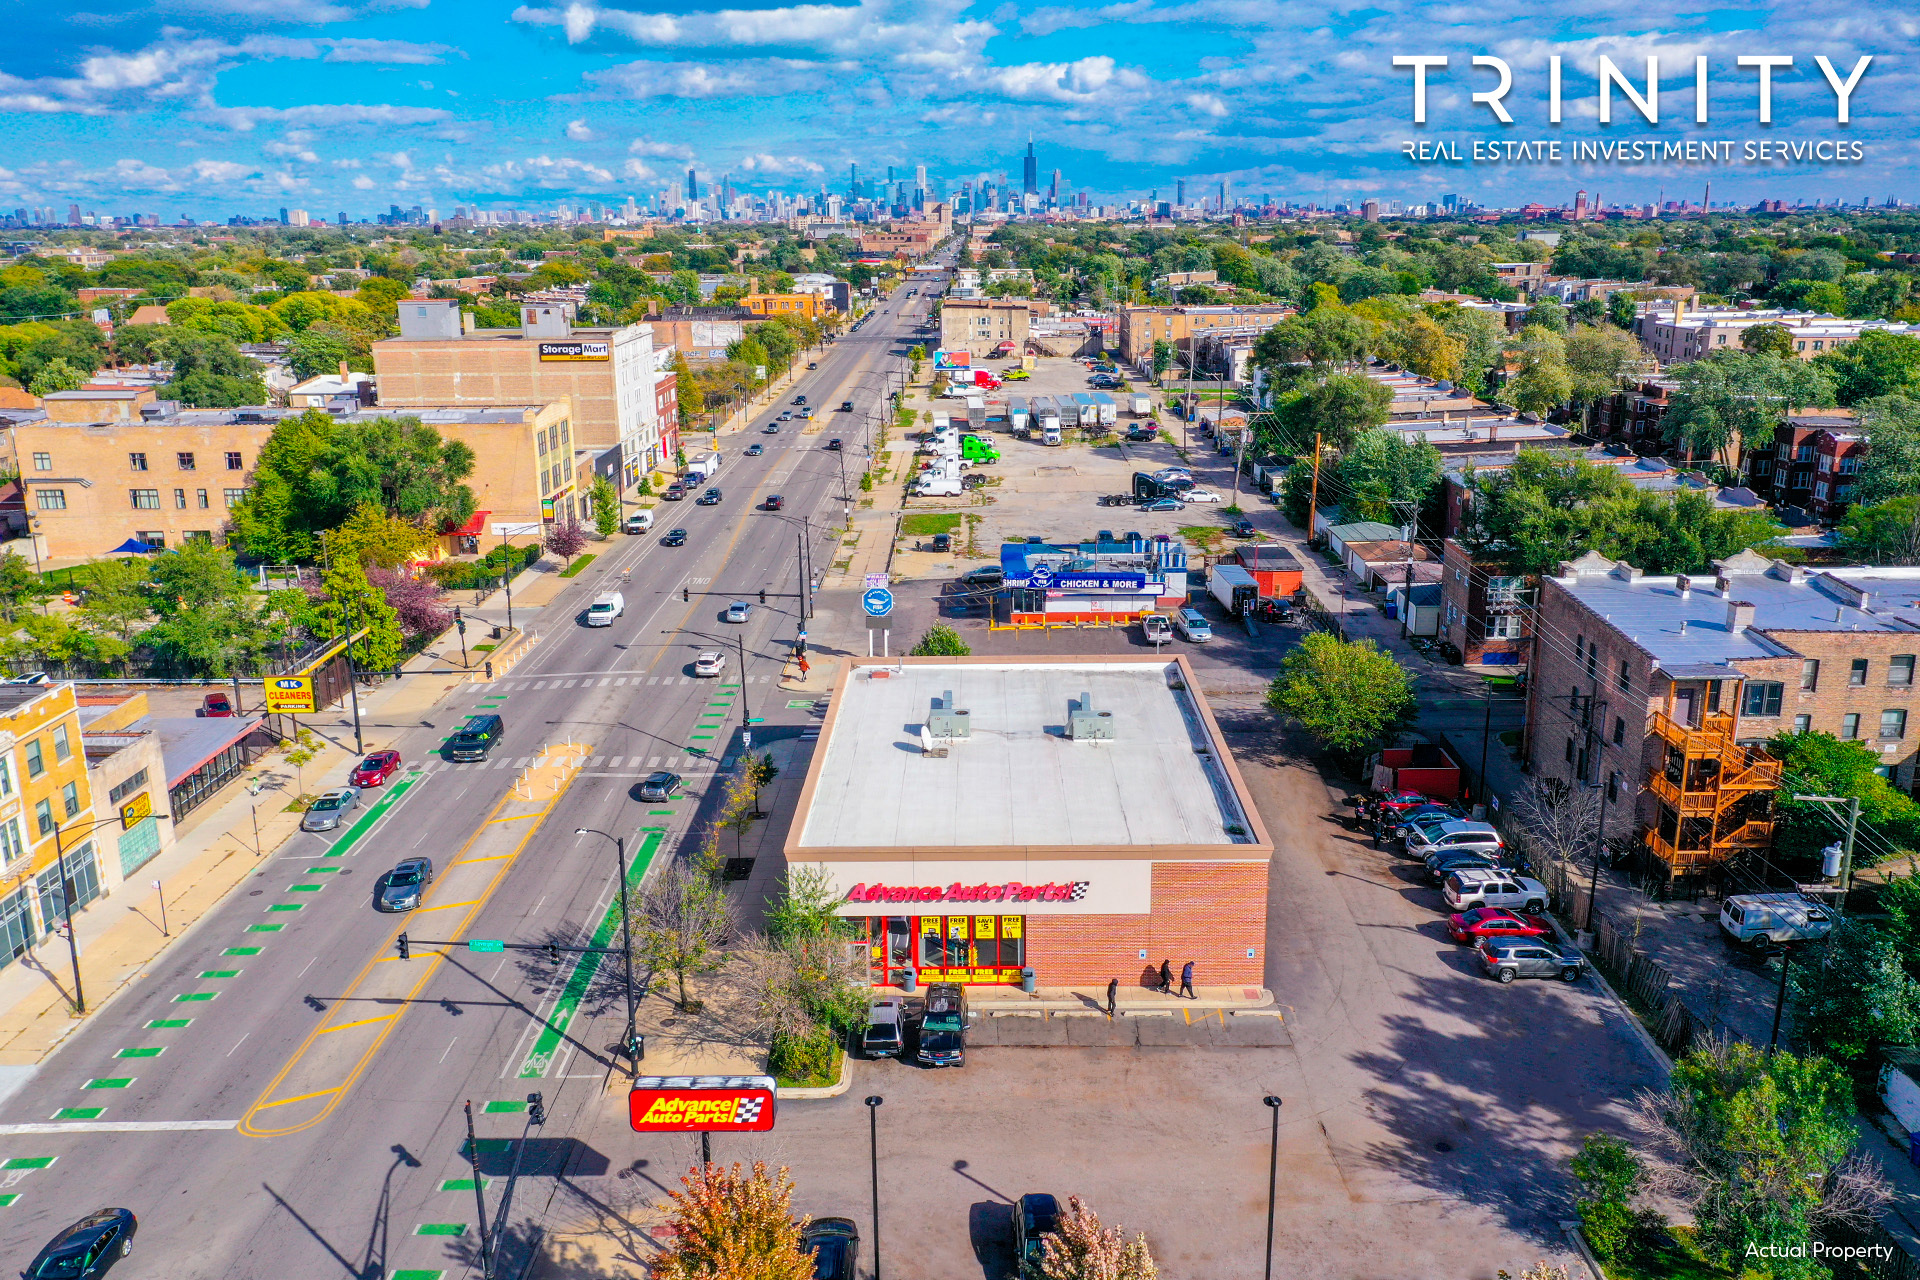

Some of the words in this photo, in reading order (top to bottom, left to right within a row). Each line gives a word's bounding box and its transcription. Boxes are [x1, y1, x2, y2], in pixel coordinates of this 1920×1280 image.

[542, 345, 581, 355] Storage
[583, 345, 606, 353] Mart
[683, 577, 711, 585] ONLY
[1003, 578, 1030, 588] SHRIMP
[1060, 580, 1099, 588] CHICKEN
[1102, 580, 1109, 588] &
[1112, 580, 1138, 588] MORE
[268, 691, 312, 700] CLEANERS
[849, 882, 942, 901] Advance
[943, 881, 1002, 900] Auto
[1002, 881, 1067, 900] Parts
[648, 1097, 732, 1112] Advance
[639, 1111, 683, 1123] Auto
[683, 1111, 730, 1123] Parts
